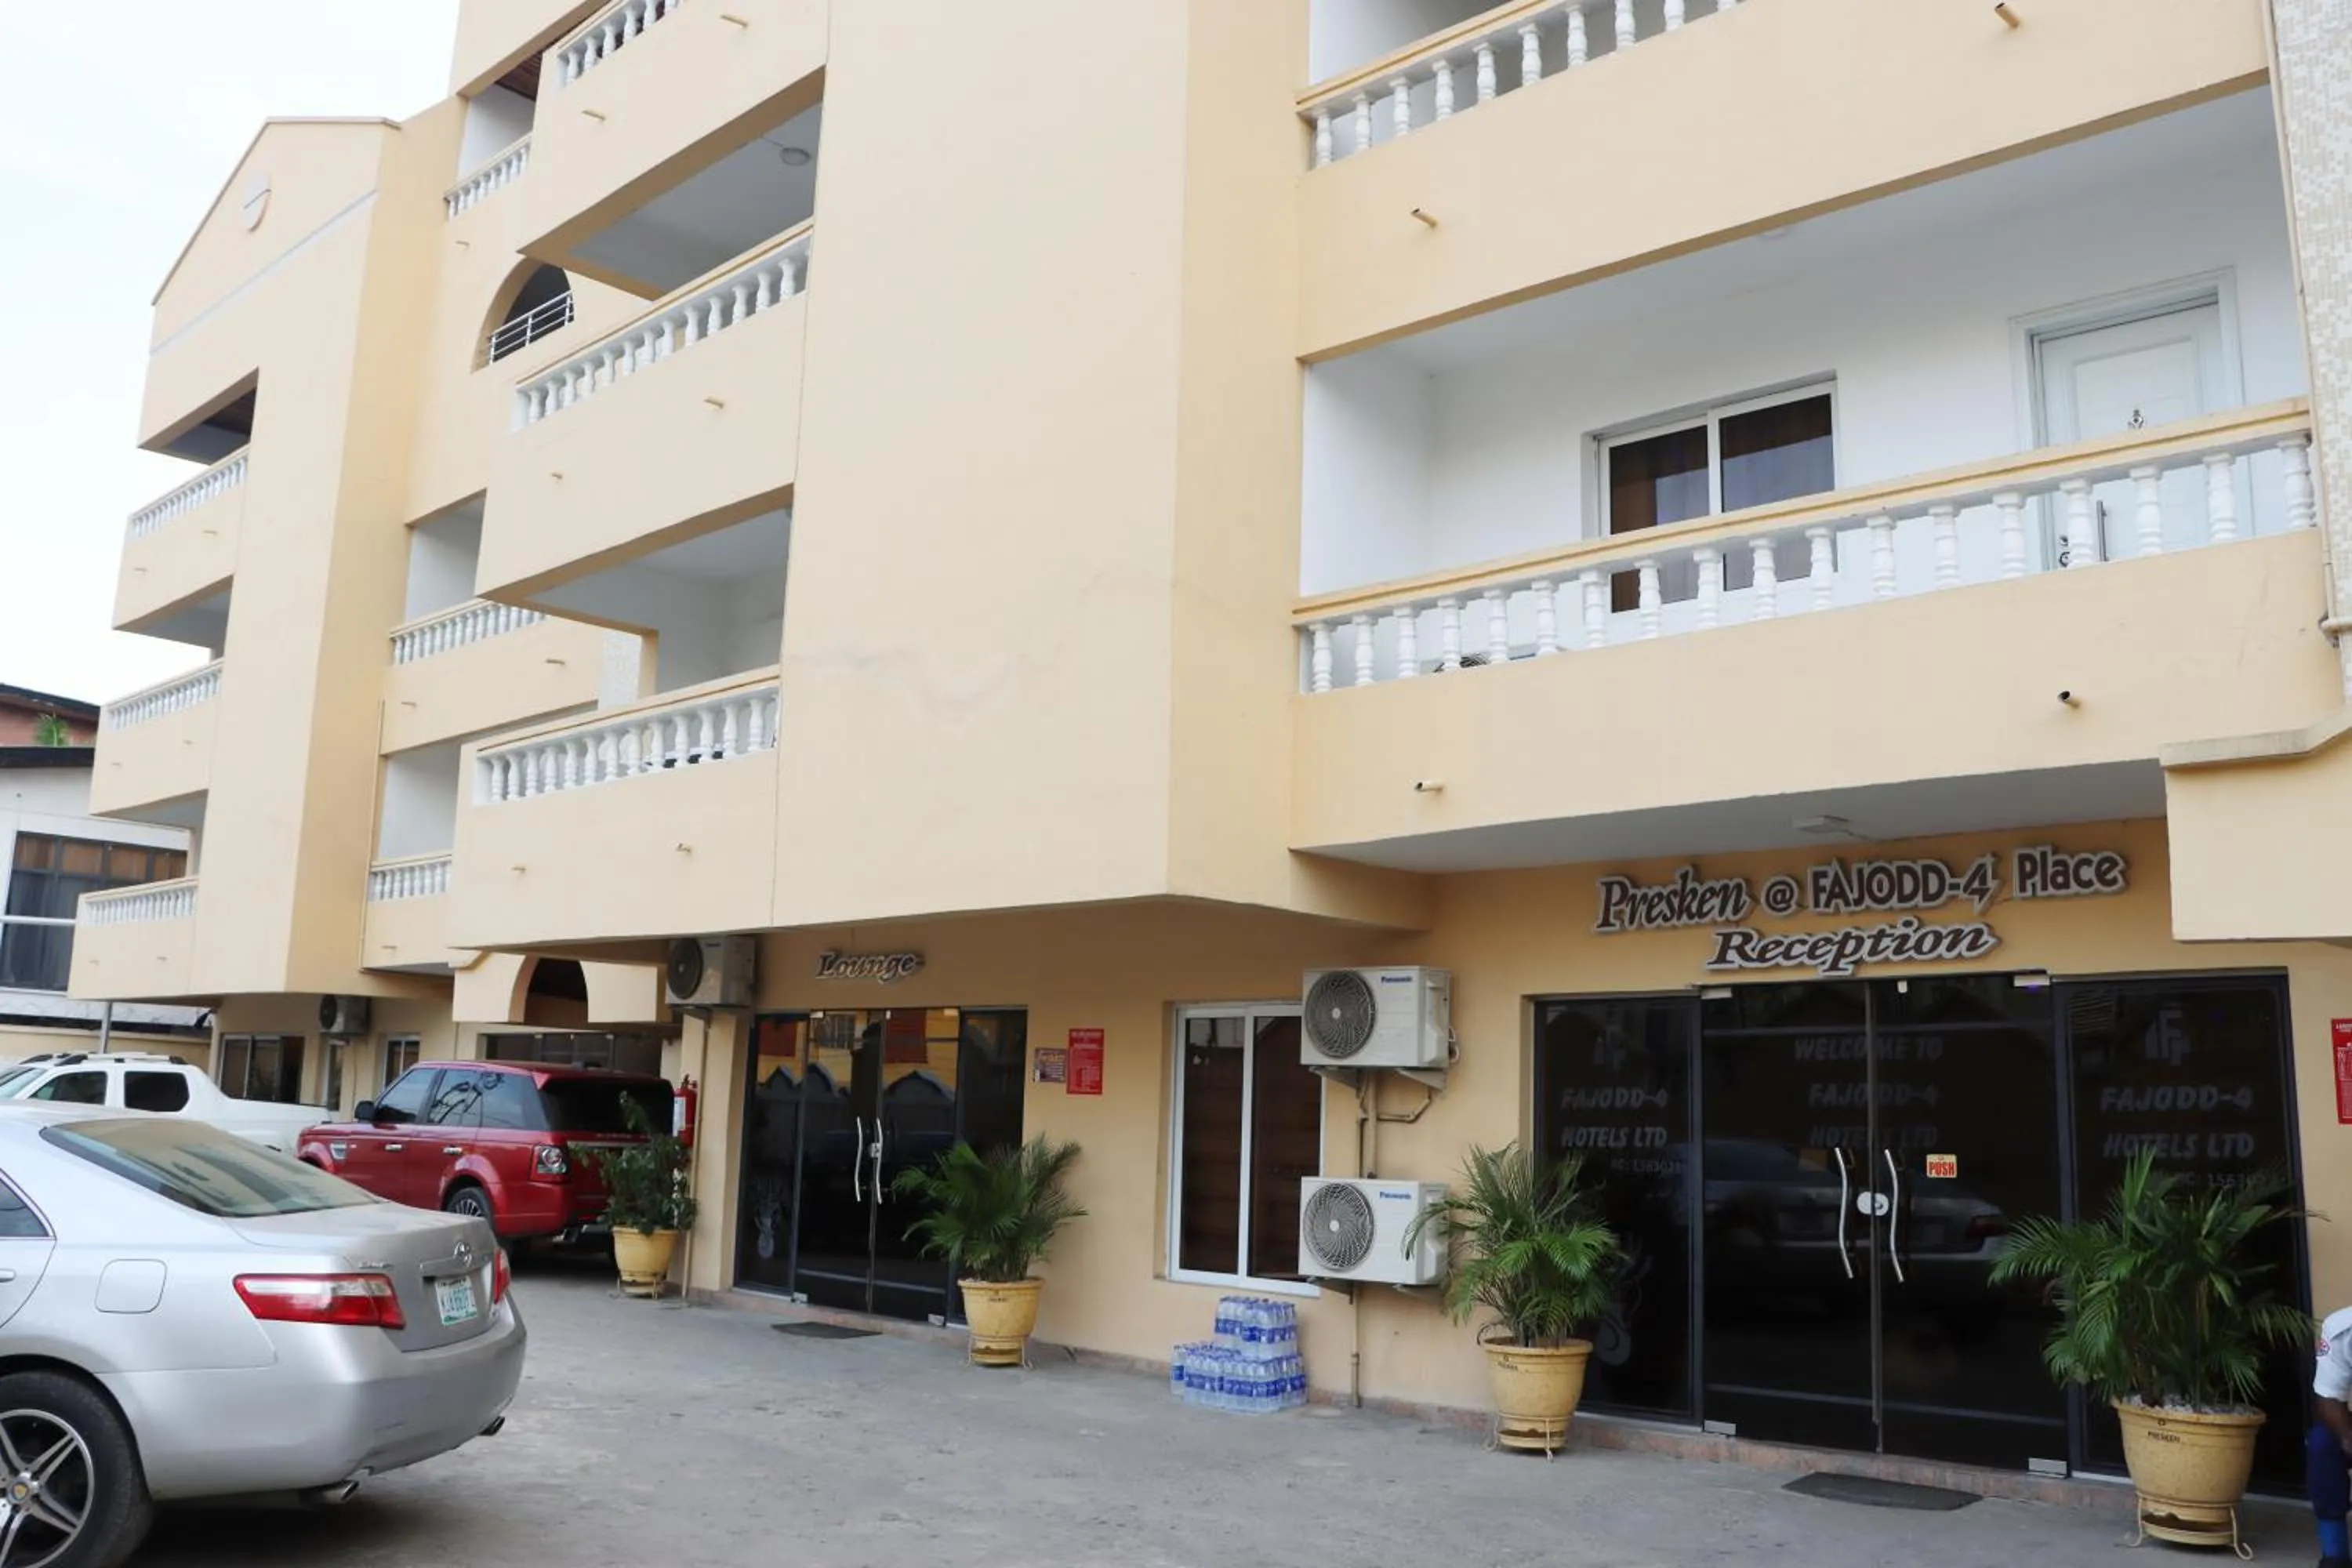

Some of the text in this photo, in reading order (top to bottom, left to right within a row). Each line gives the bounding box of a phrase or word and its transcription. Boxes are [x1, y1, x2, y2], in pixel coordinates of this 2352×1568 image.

[1595, 848, 2124, 931] Presken @ FAJODD-4 Place
[1706, 916, 1995, 974] Reception
[815, 951, 916, 984] Lounge
[1560, 1126, 1668, 1148] HOTELS LTD
[2206, 1133, 2255, 1159] LTD
[1929, 1162, 1955, 1176] PUSH
